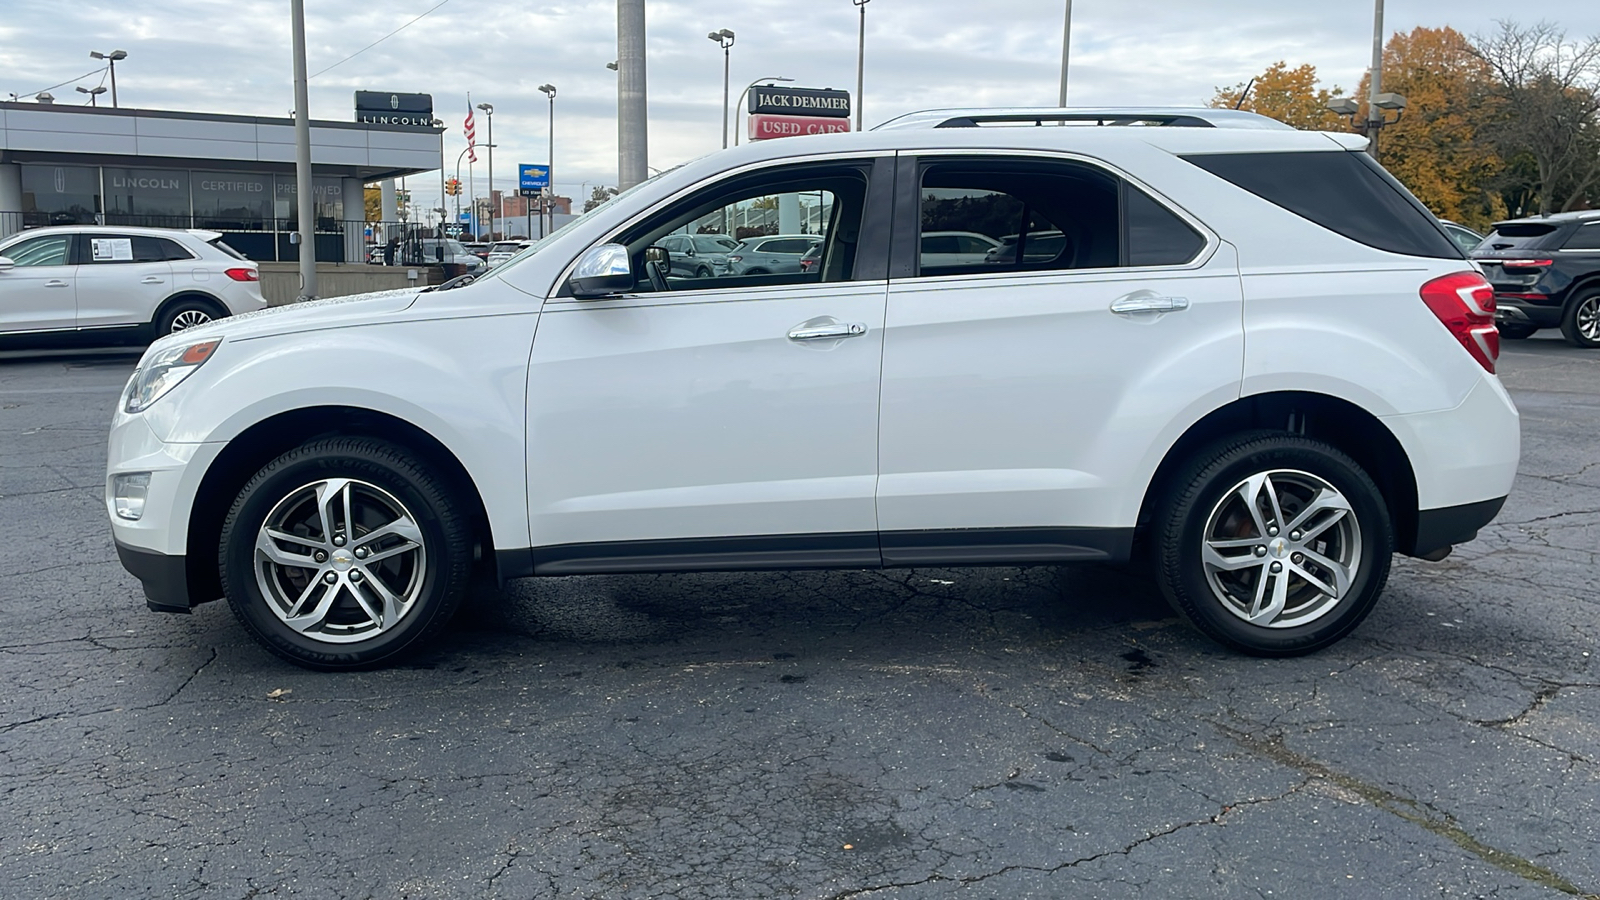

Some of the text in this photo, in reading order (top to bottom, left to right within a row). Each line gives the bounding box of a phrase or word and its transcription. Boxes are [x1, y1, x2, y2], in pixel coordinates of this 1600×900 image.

[759, 94, 849, 109] JACK DEMMER
[363, 116, 428, 126] LINCOLN
[763, 121, 845, 135] USED CARS
[113, 177, 179, 189] LINCOLN
[201, 180, 263, 192] CERTIFIED
